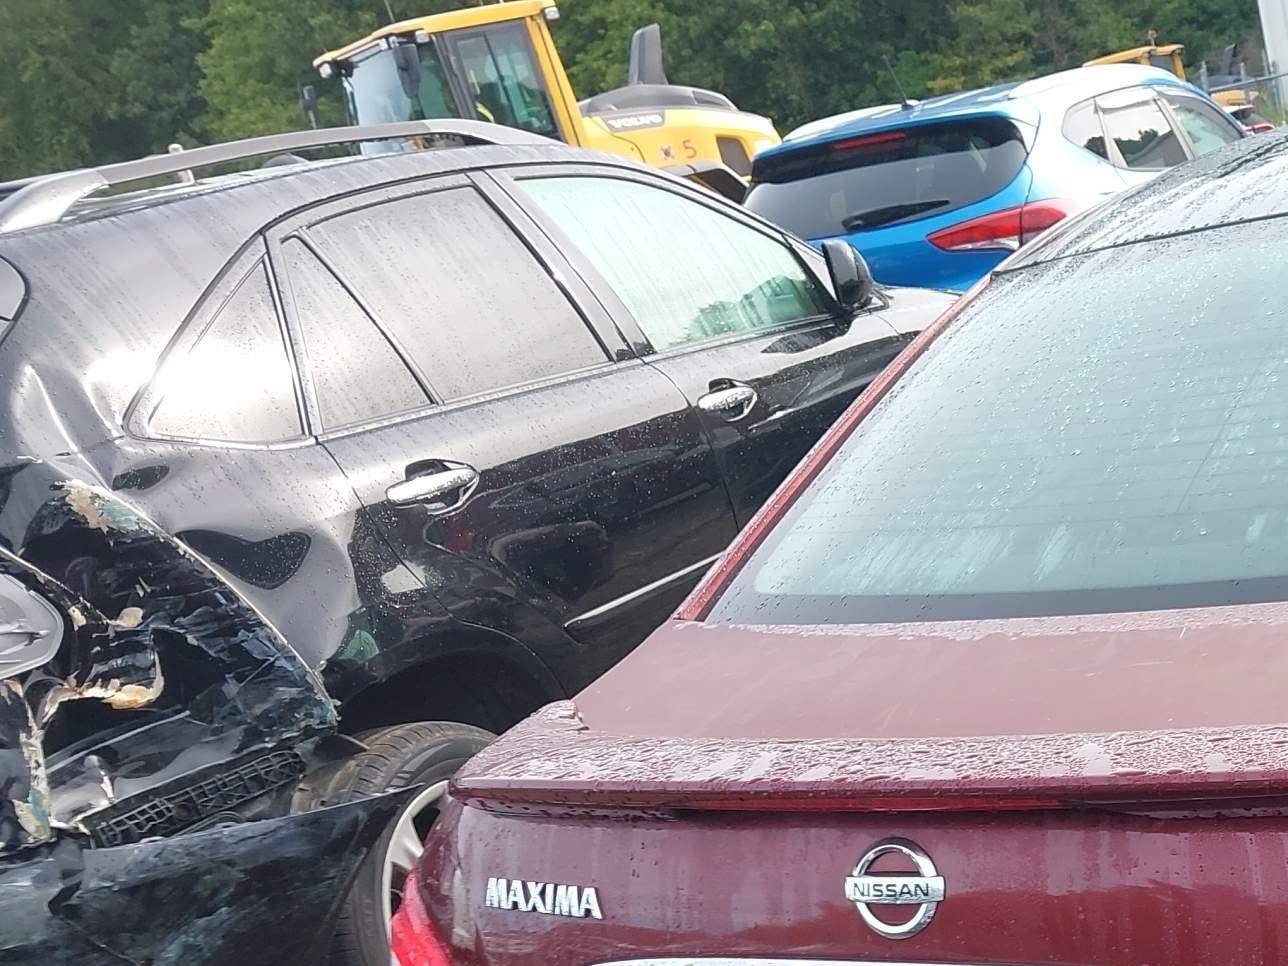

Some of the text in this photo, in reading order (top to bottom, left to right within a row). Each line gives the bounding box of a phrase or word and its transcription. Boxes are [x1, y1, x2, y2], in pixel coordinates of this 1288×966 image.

[607, 114, 663, 128] VOLVO
[682, 139, 697, 159] 5
[485, 877, 603, 920] MAXIMA
[853, 882, 930, 898] NISSAN
